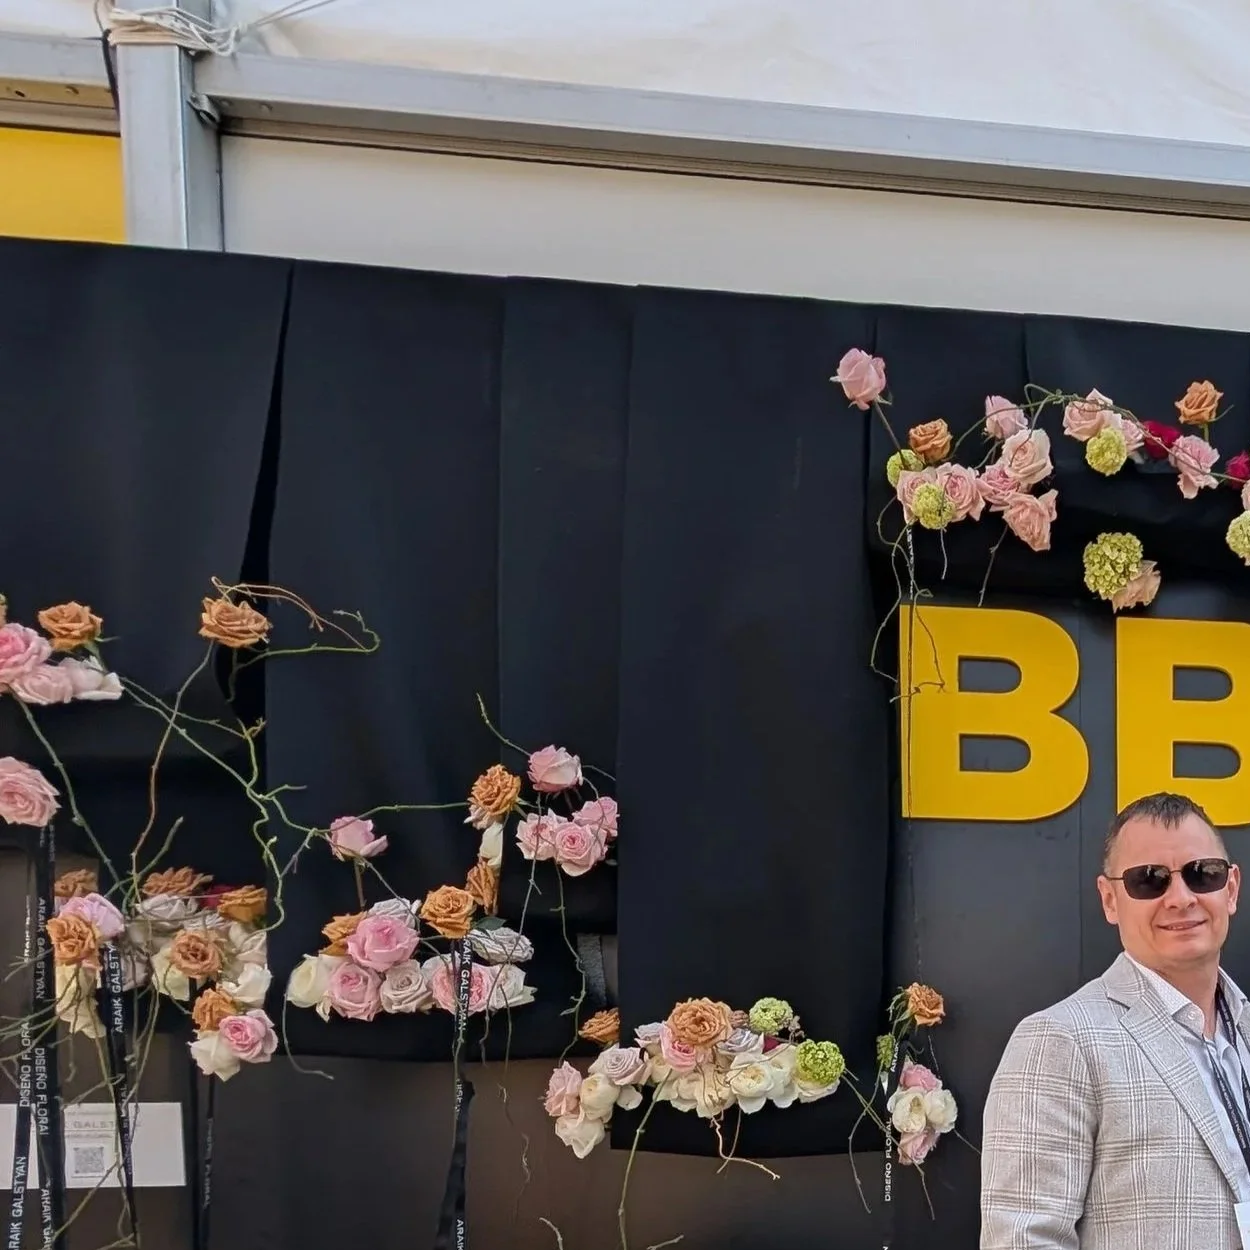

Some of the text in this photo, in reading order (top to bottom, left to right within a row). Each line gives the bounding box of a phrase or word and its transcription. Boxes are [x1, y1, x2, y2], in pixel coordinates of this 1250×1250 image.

[36, 898, 46, 933] ARAIK
[462, 938, 472, 966] RAIK
[109, 943, 124, 1034] ARAIK GALSTY
[13, 1156, 27, 1218] GALSTYAN
